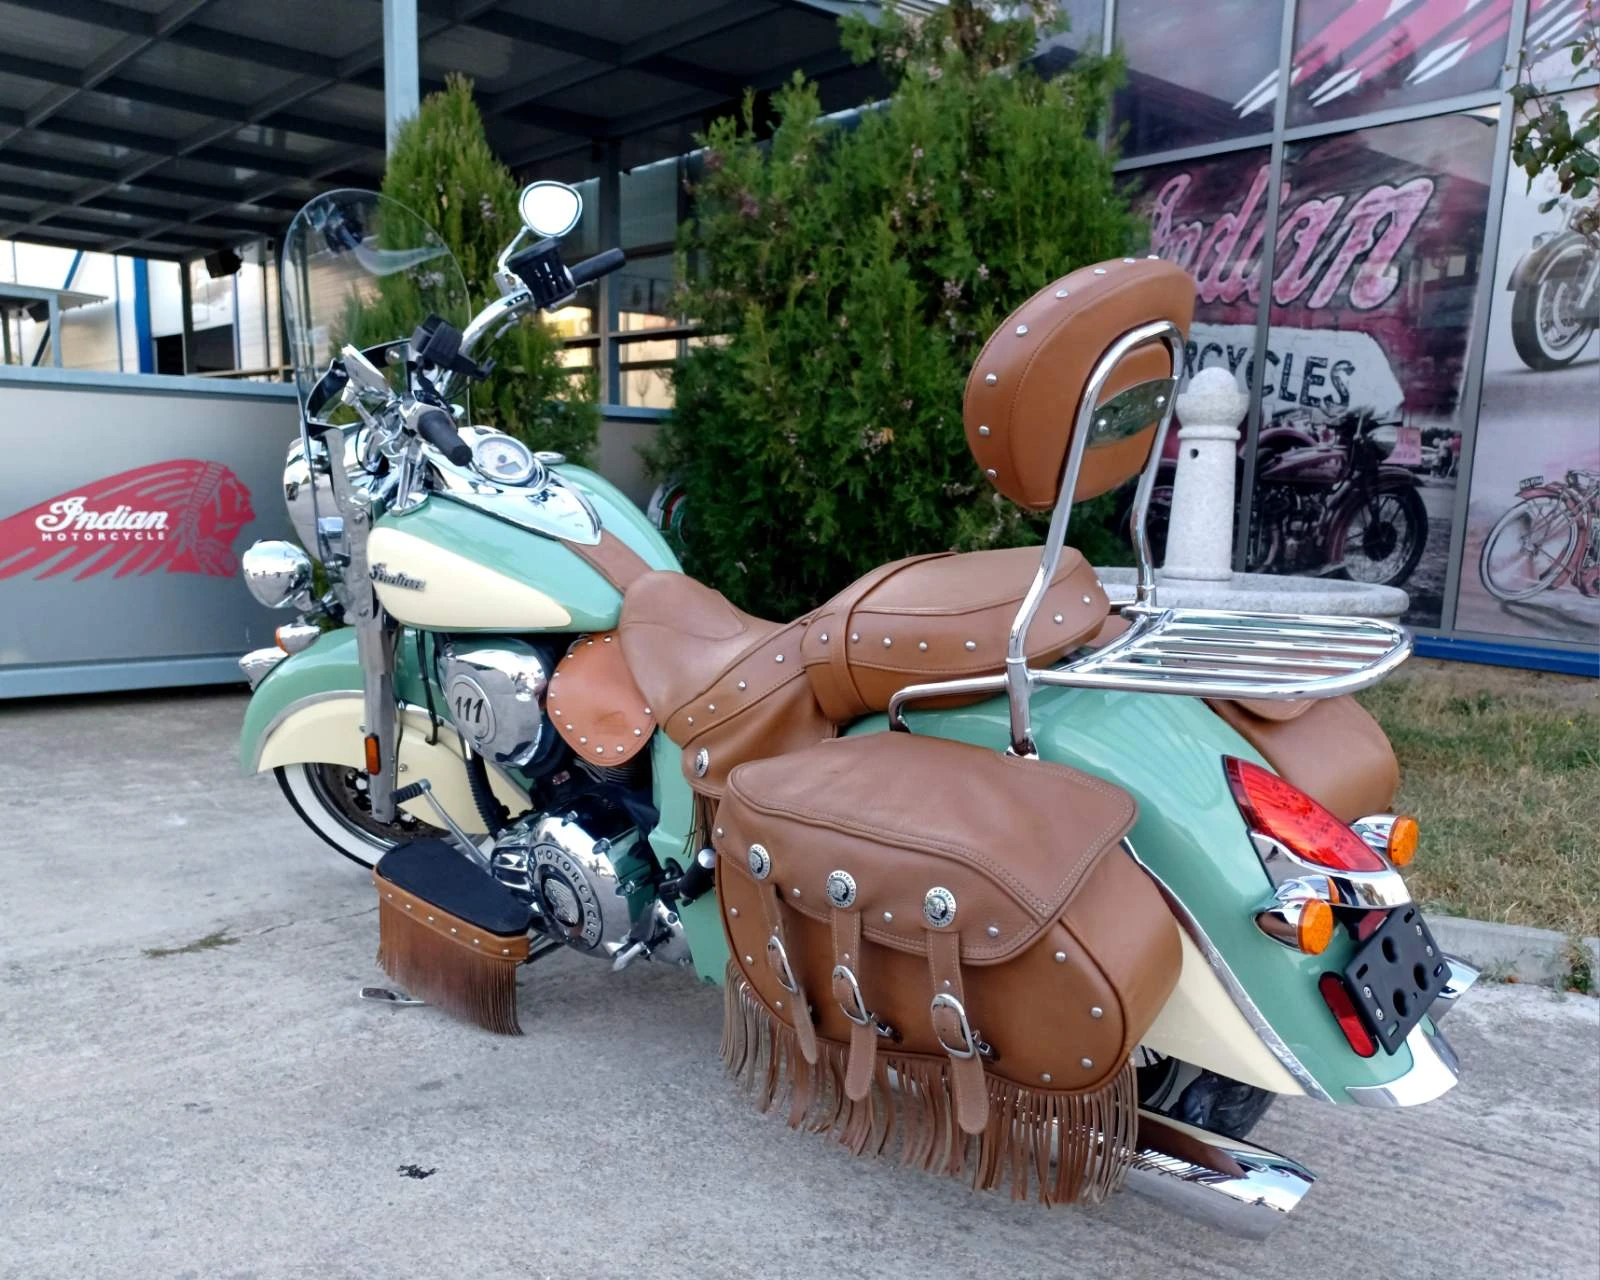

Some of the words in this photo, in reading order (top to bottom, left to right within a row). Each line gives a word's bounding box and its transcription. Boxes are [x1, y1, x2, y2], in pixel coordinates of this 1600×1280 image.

[35, 496, 169, 532] Indian
[41, 531, 166, 542] MOTORCYCLE
[455, 696, 484, 723] 111
[537, 848, 598, 939] MOTORCYCLE
